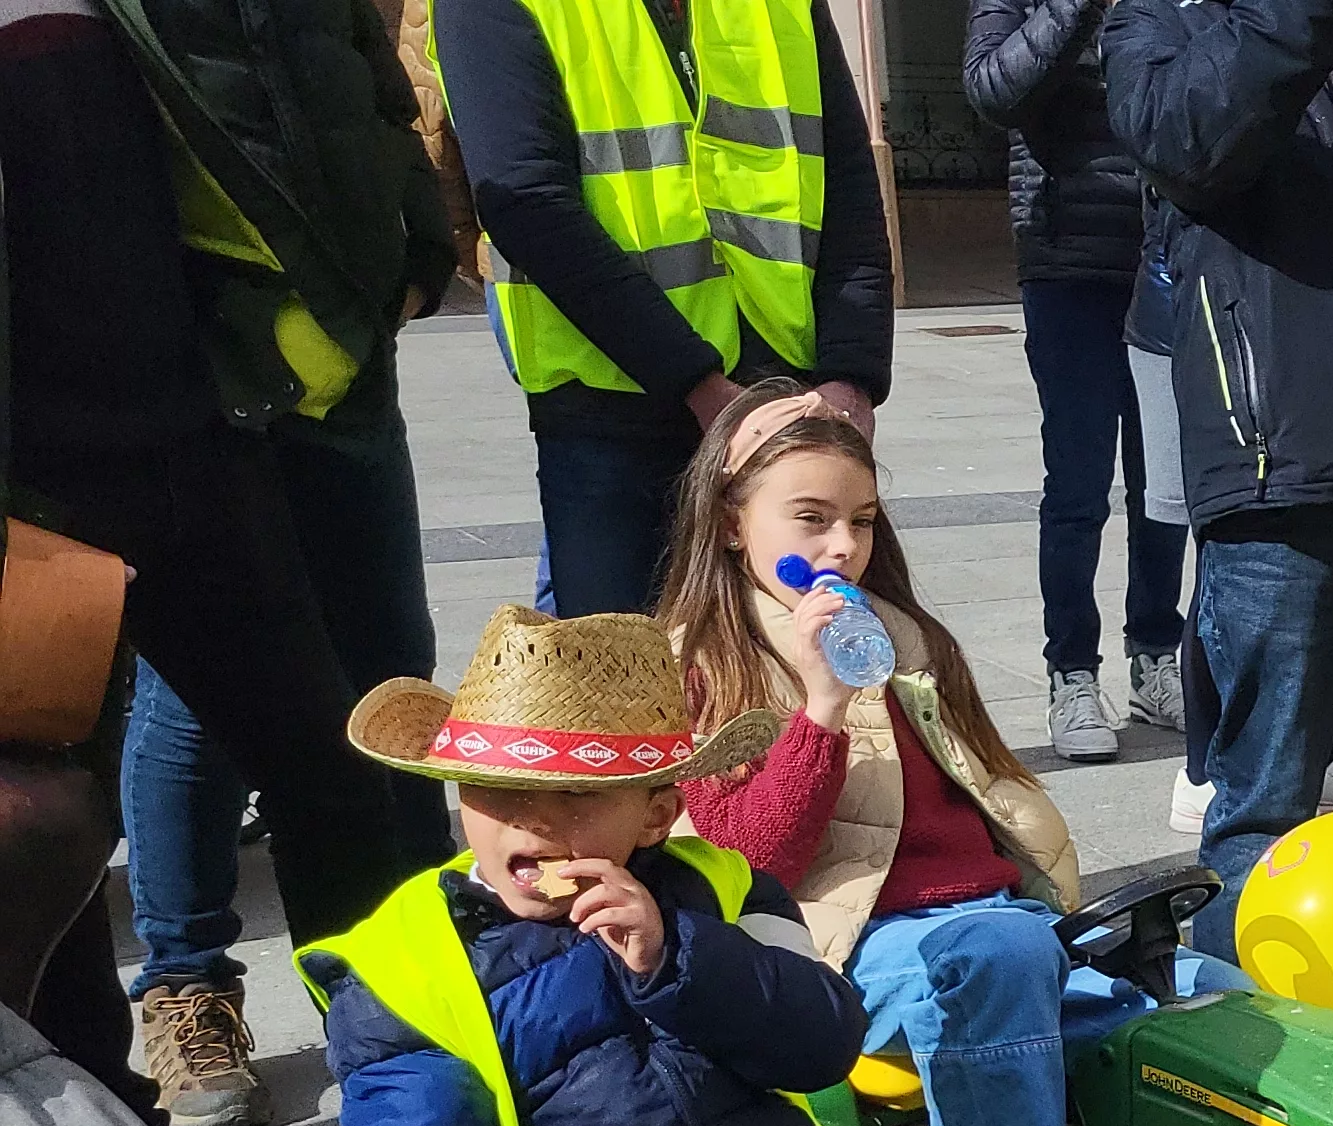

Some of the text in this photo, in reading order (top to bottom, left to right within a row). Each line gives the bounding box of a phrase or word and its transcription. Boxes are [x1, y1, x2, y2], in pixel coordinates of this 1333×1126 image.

[461, 739, 485, 751] KUHN
[511, 744, 548, 757] KUHN
[578, 747, 612, 760] KUHN
[635, 751, 660, 761] KUHN
[1143, 1068, 1212, 1105] JOHN DEERE
